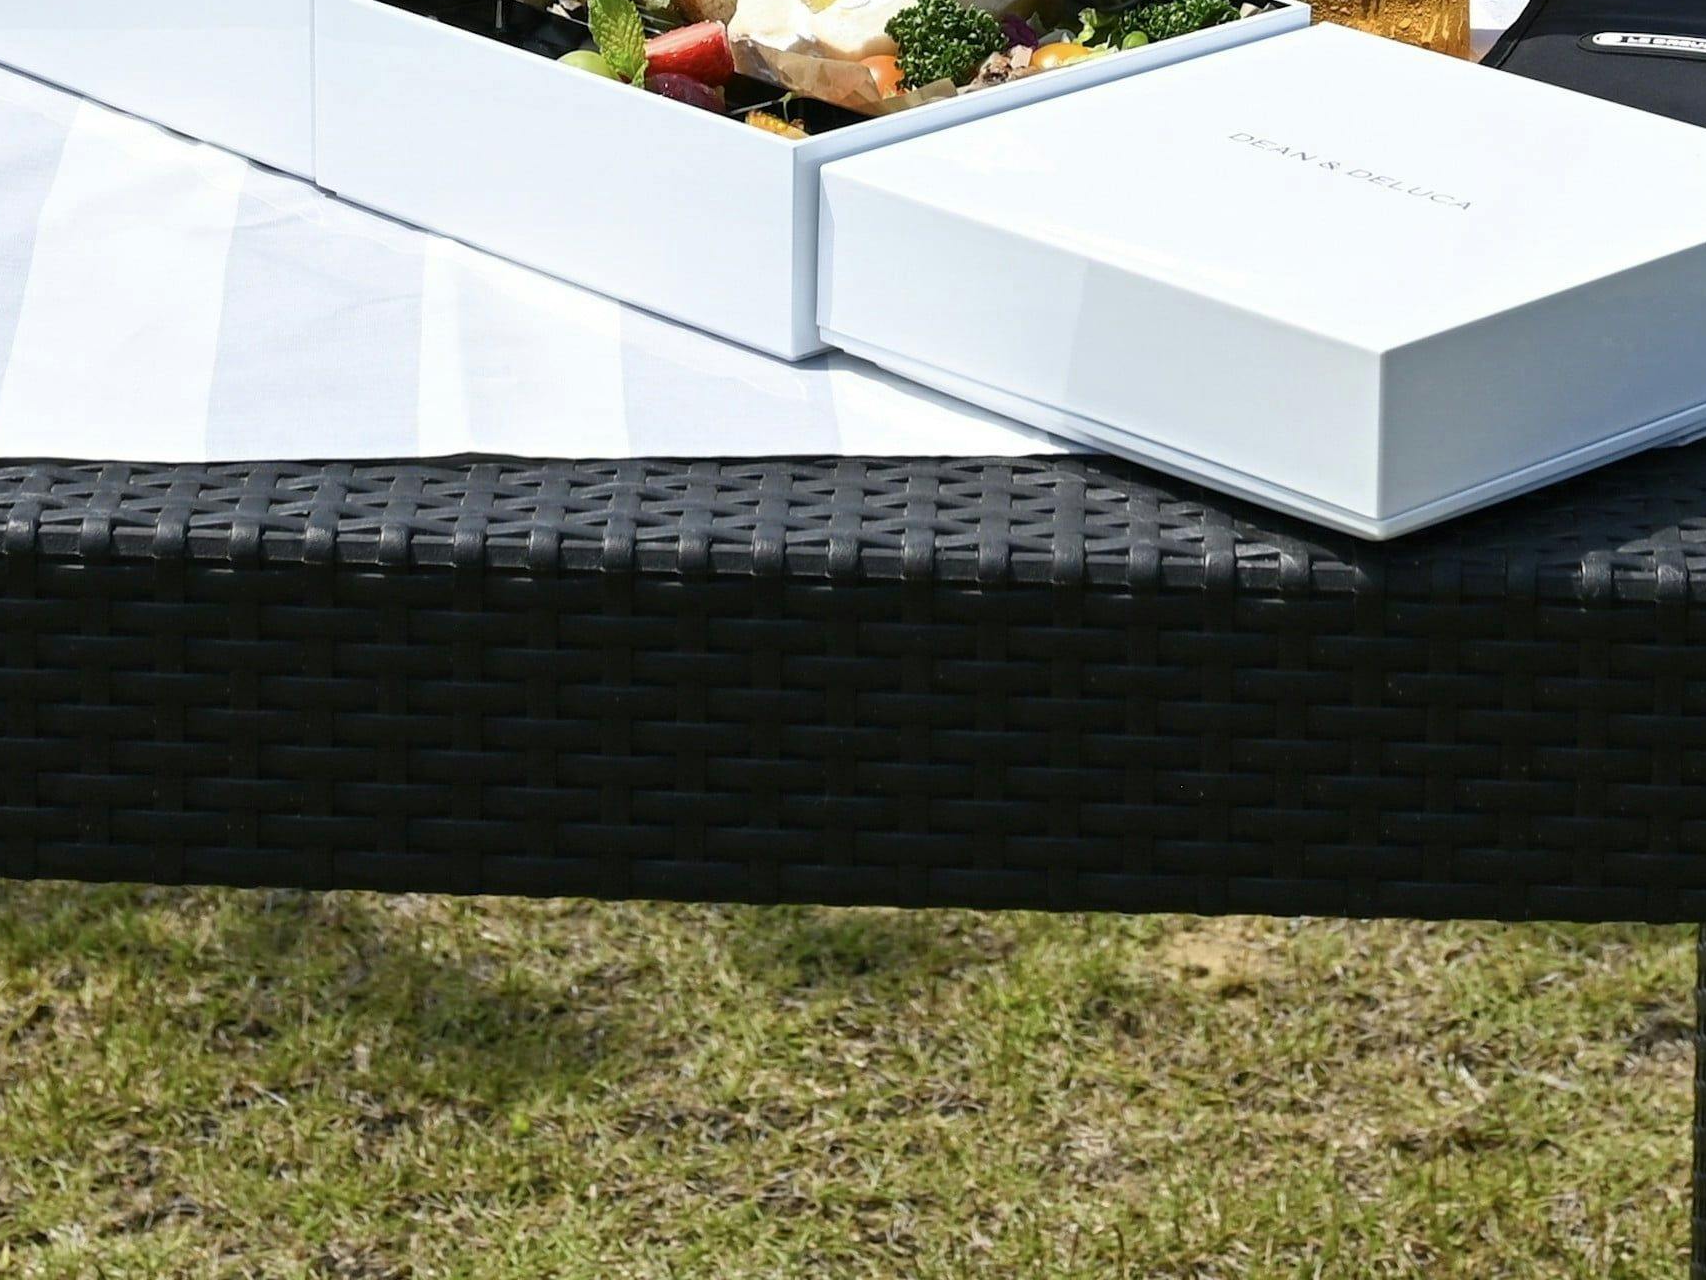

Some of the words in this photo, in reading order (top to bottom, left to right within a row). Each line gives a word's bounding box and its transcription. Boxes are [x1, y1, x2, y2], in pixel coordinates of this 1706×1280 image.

[1228, 132, 1318, 162] DEAN
[1318, 160, 1341, 171] &
[1345, 168, 1472, 211] DELUCA
